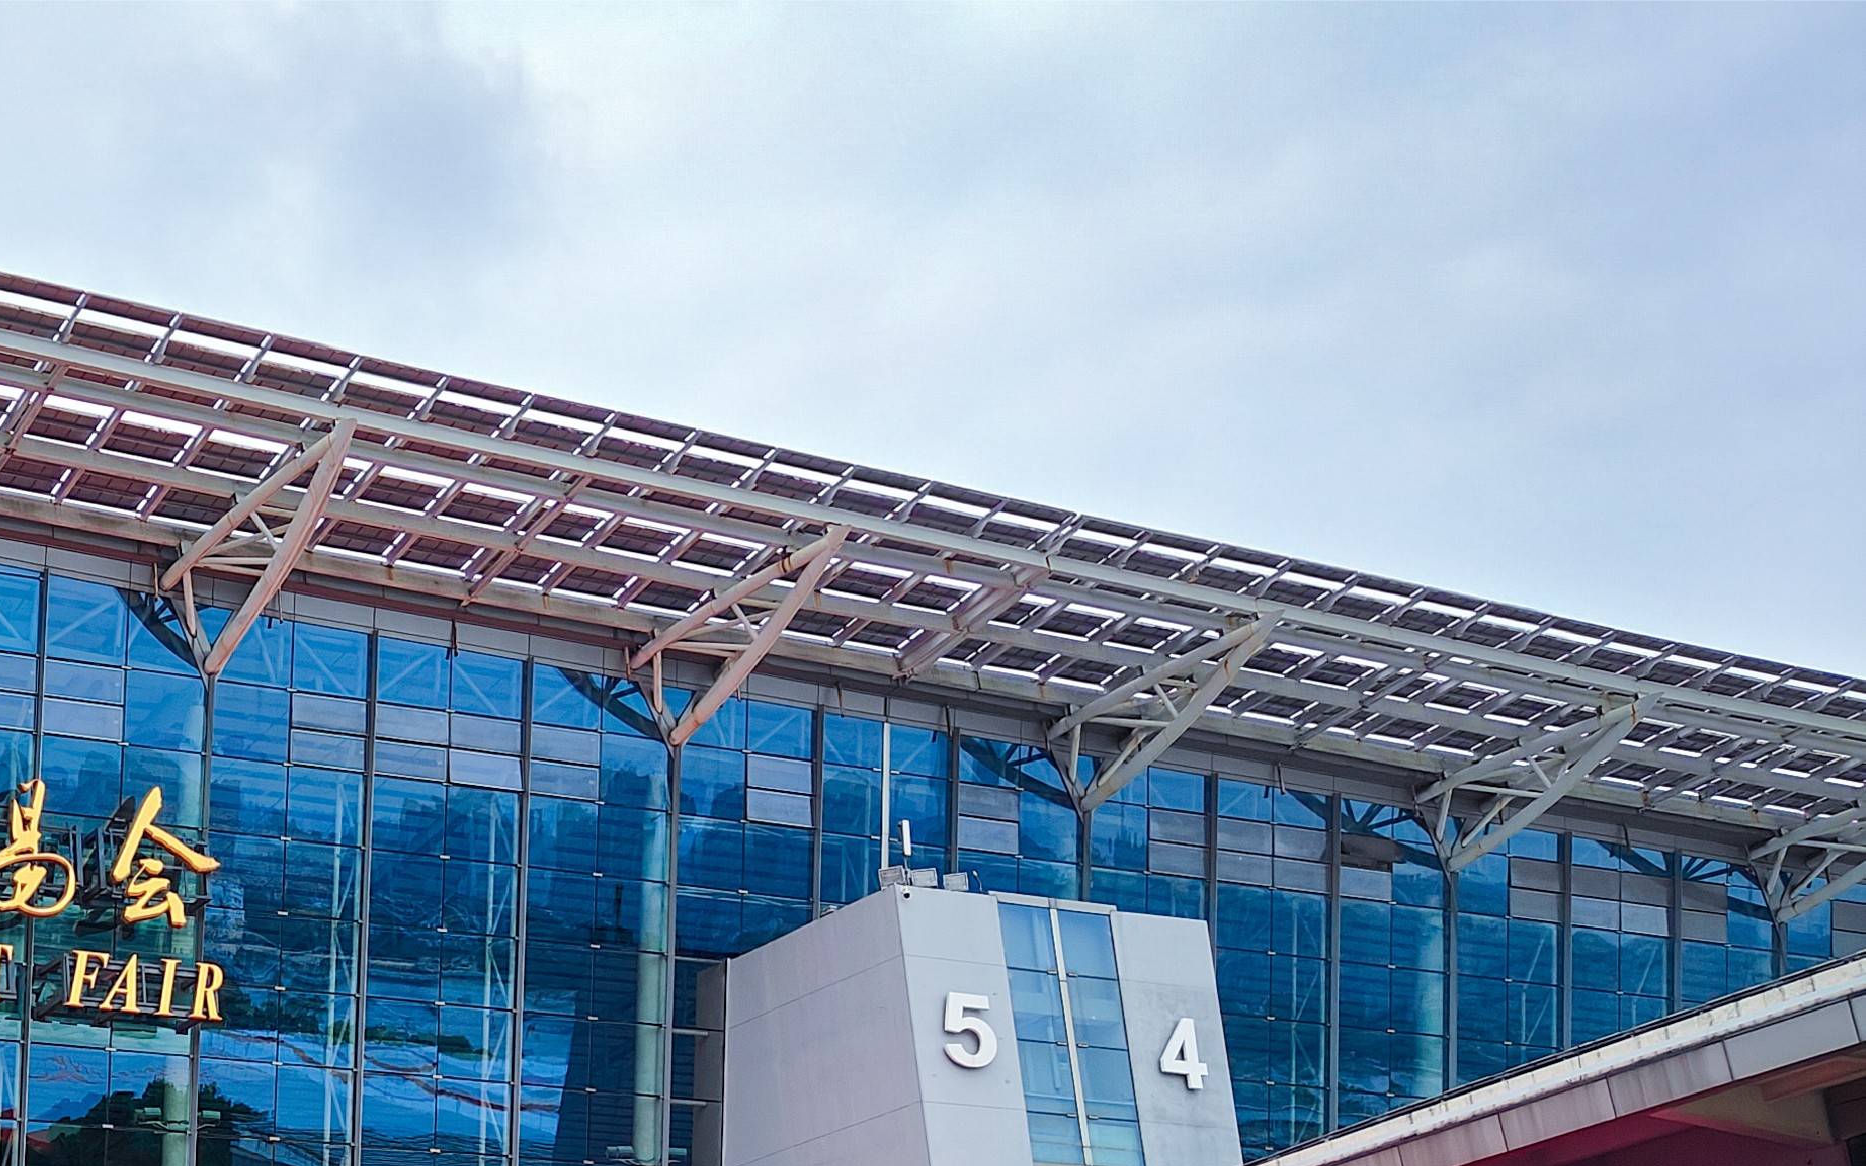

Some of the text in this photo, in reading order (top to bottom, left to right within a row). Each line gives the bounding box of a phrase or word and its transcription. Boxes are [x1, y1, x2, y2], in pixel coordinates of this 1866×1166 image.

[65, 949, 225, 1023] FAIR
[944, 991, 998, 1068] 5
[1158, 1017, 1209, 1090] 4
